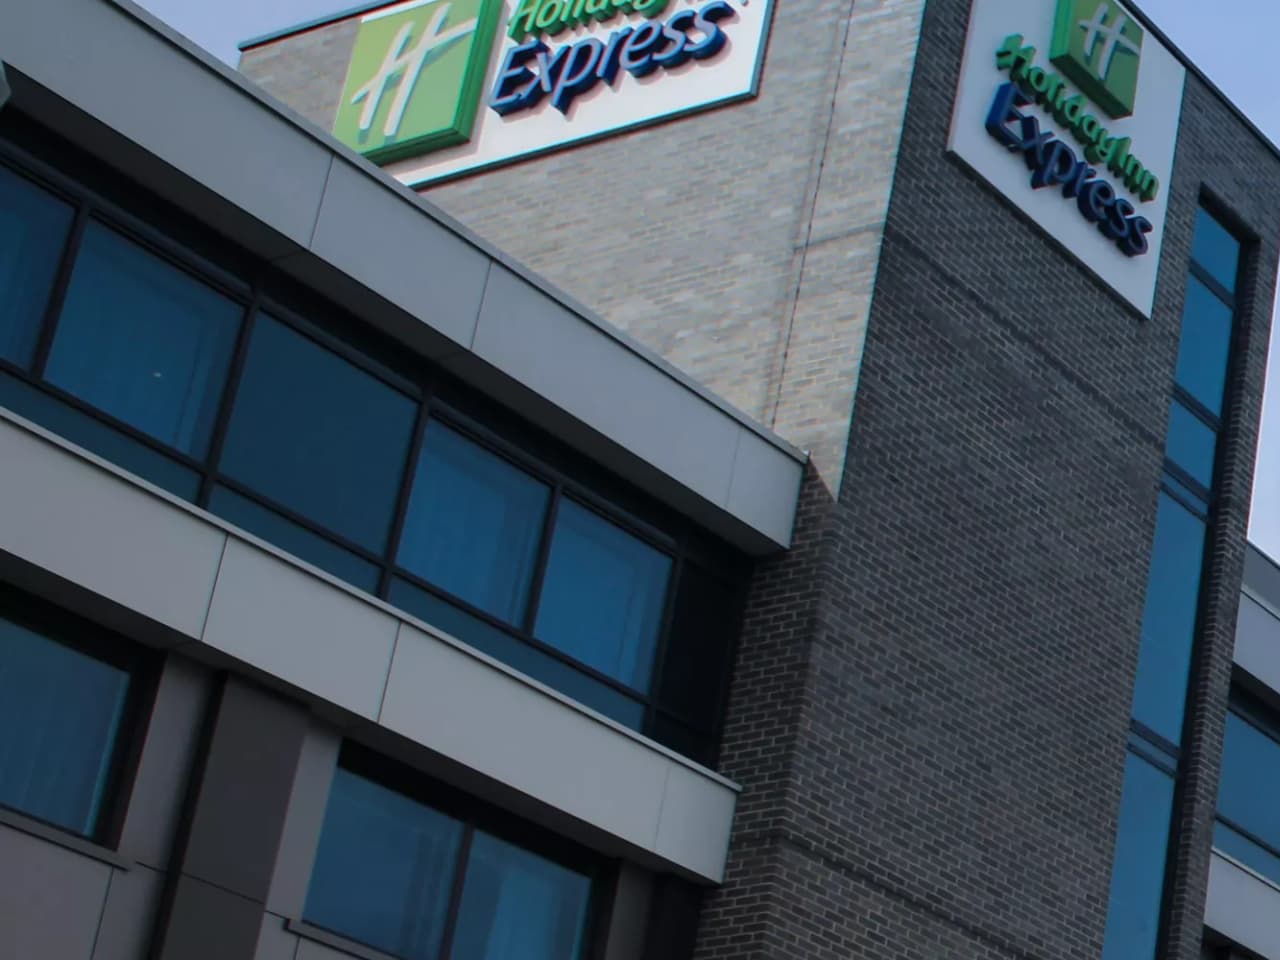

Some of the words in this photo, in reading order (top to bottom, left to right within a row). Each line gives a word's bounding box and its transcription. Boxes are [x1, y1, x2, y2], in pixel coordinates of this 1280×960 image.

[487, 2, 736, 117] Express
[996, 33, 1114, 165] Holiday
[1107, 137, 1159, 203] Inn
[985, 80, 1153, 257] Express
